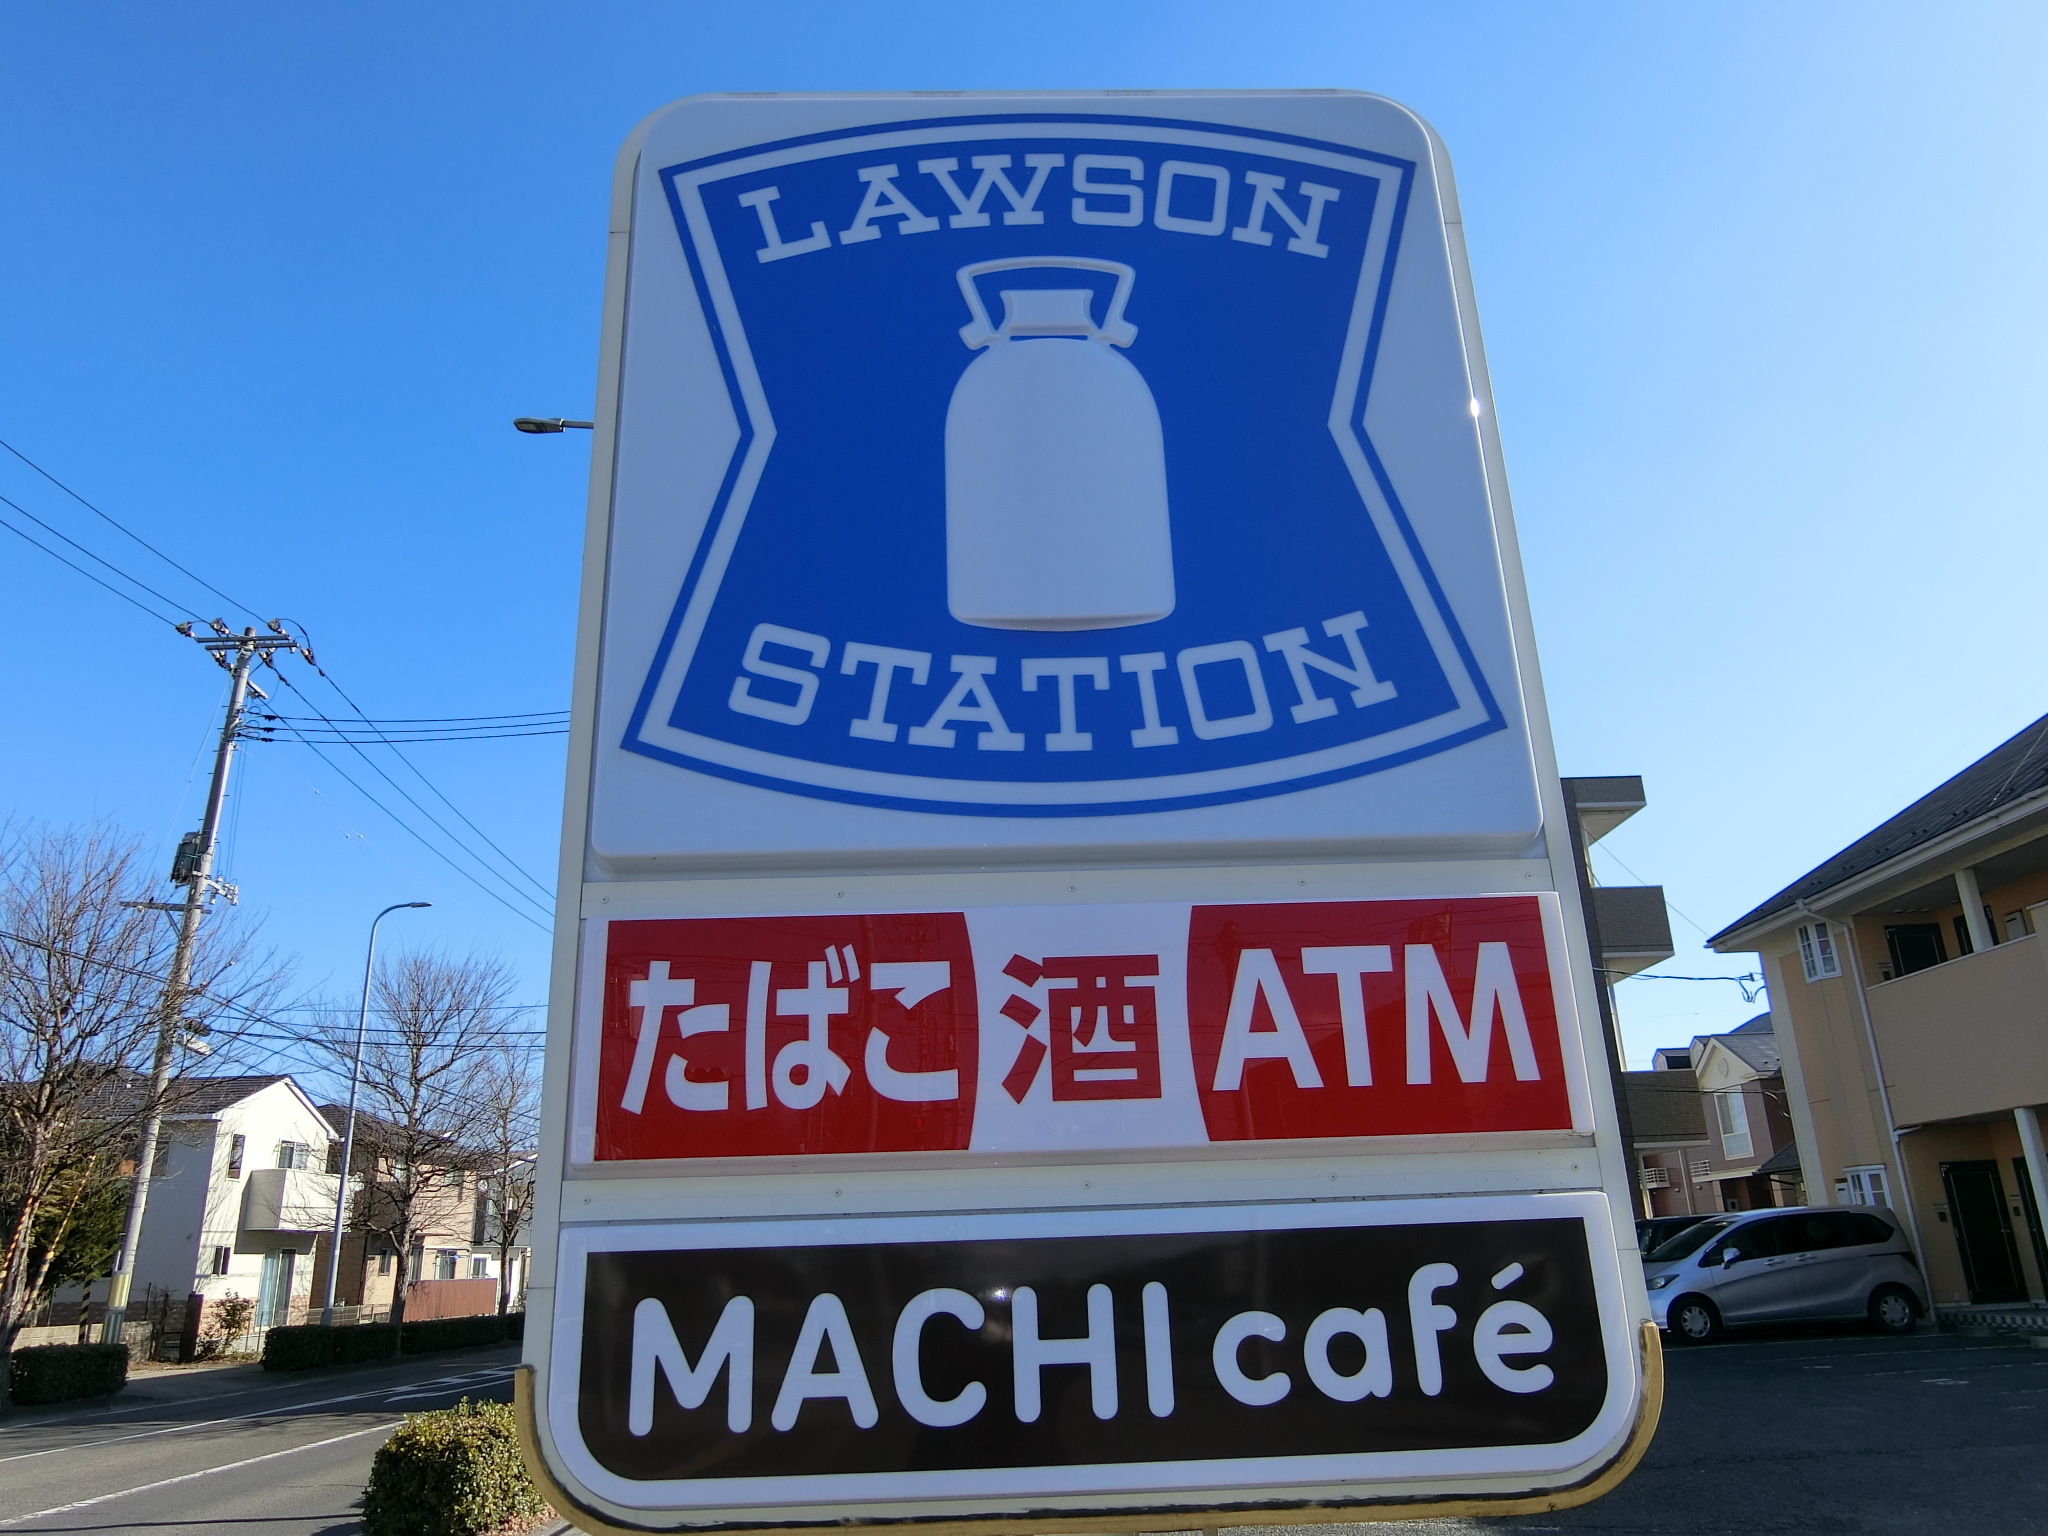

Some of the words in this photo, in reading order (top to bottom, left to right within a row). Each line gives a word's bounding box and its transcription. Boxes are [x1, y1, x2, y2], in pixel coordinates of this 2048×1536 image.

[739, 153, 1341, 264] LAWSON
[727, 610, 1398, 752] STATION
[620, 944, 960, 1115] たばこ
[1000, 952, 1162, 1105] 酒
[1212, 941, 1542, 1091] ATM
[628, 1280, 1175, 1437] MACHI
[1212, 1261, 1554, 1407] café
